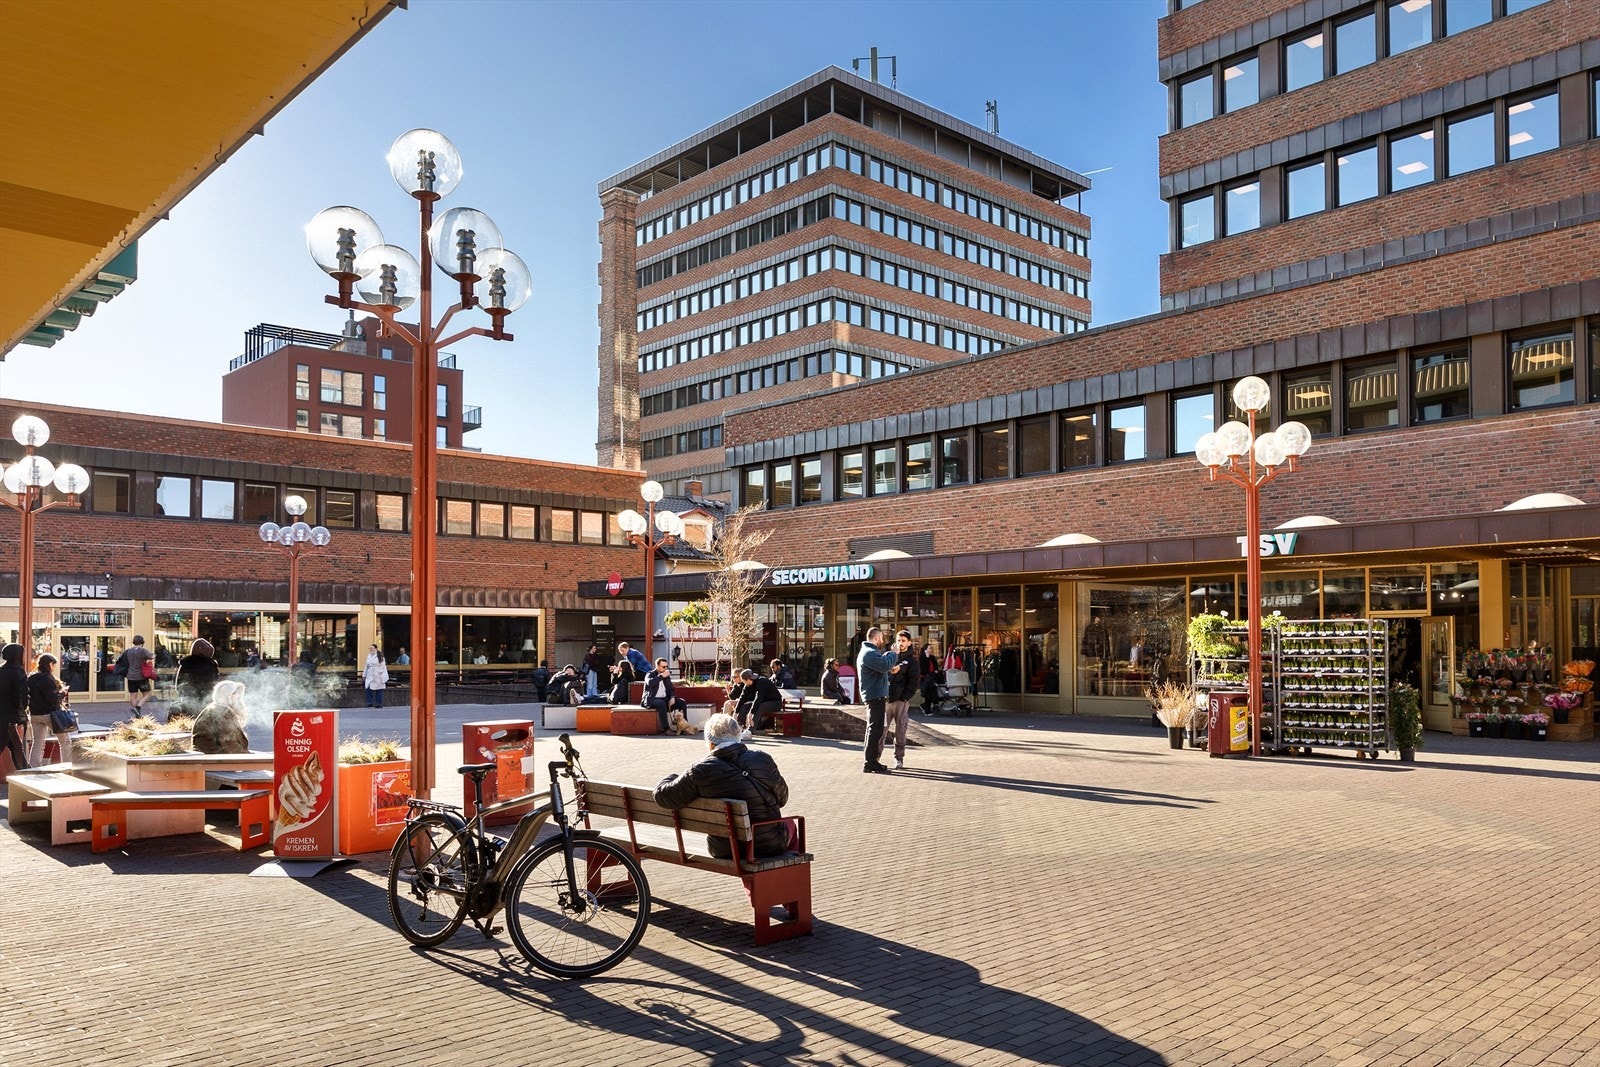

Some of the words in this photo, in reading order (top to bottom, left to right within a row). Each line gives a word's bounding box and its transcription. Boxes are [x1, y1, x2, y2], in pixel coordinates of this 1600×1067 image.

[1236, 533, 1298, 557] TSV
[772, 568, 828, 585] SECOND
[828, 564, 874, 581] HAND
[36, 583, 108, 598] SCENE
[62, 613, 125, 624] POSTKONORET
[287, 745, 310, 753] OLSEN
